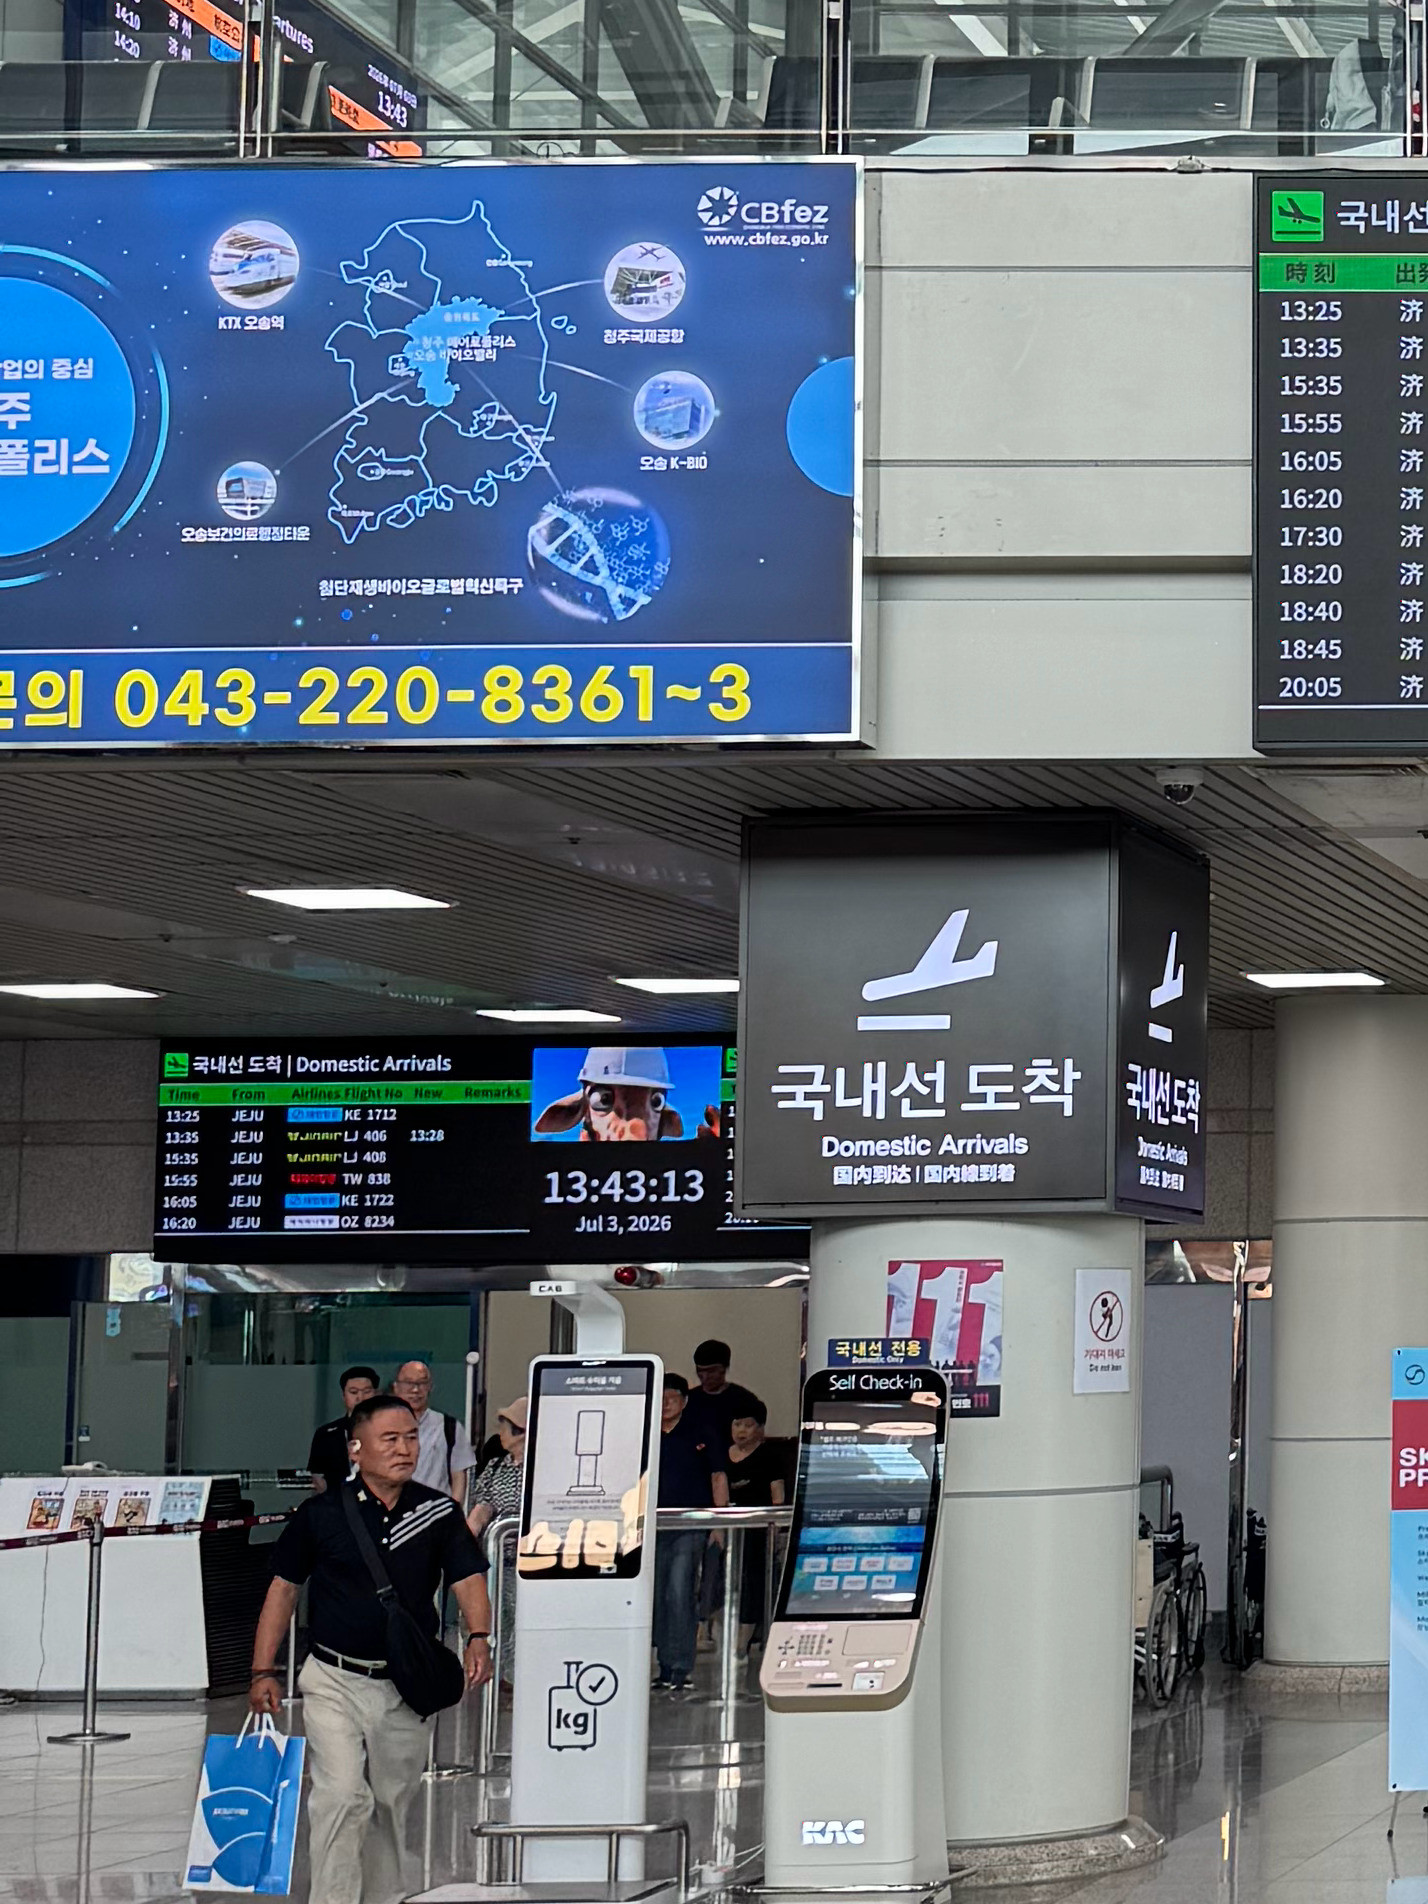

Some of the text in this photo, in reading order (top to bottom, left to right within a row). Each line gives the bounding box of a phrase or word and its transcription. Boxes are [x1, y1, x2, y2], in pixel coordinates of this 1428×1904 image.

[376, 91, 408, 128] 13:43
[740, 198, 829, 225] CBfez
[703, 231, 830, 247] www.cbfez.go.kr
[1285, 261, 1336, 284] 時刻
[218, 315, 285, 331] KTX 오송역
[1280, 337, 1343, 358] 13:35
[0, 358, 94, 379] 업의 중심
[640, 456, 708, 471] 오송 K-BIO
[0, 662, 752, 729] 의 043-220-8361~3
[192, 1053, 452, 1075] 국내선 도착 Domestic Arrivals
[770, 1058, 1082, 1121] 국내선 도착
[165, 1108, 397, 1123] 13:25 JEJU KE 1712
[821, 1132, 1030, 1158] Domestic Arrivals
[544, 1169, 705, 1204] 13:43:13
[574, 1214, 672, 1236] Jul 3, 2026
[835, 1340, 921, 1358] 국내선 전용
[829, 1374, 922, 1390] Self Check-in
[555, 1706, 589, 1737] kg
[801, 1819, 866, 1846] KAC
